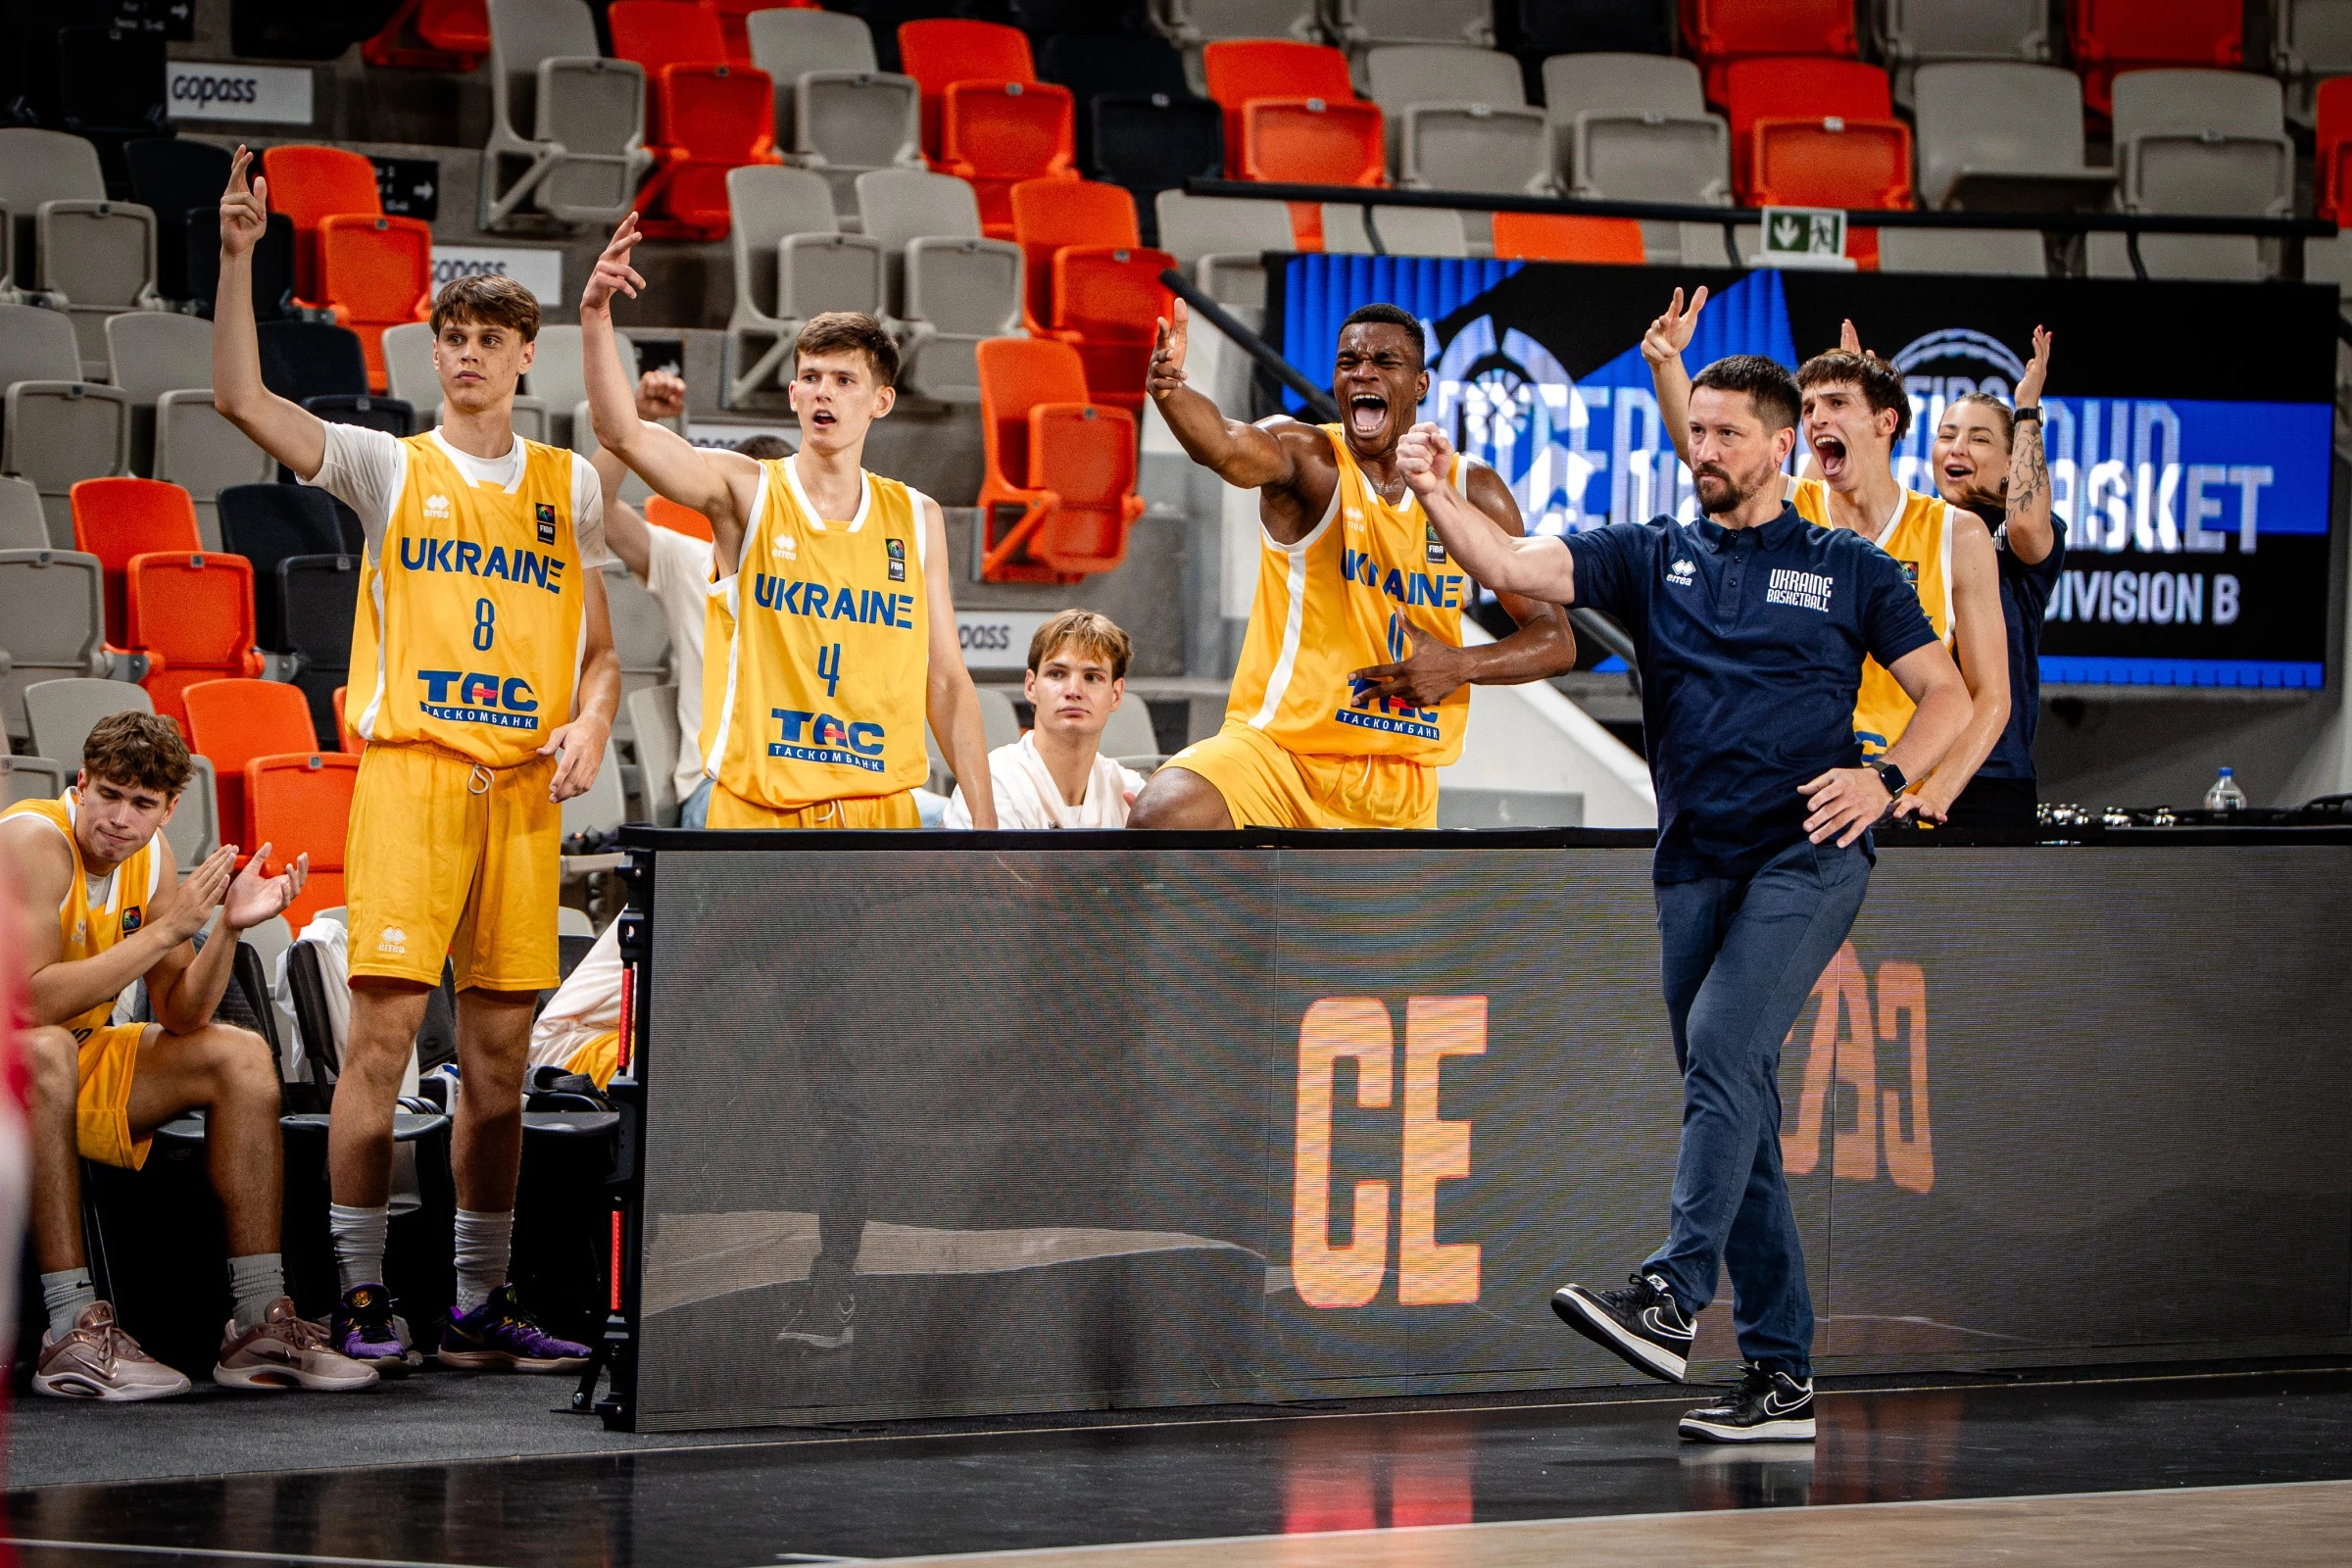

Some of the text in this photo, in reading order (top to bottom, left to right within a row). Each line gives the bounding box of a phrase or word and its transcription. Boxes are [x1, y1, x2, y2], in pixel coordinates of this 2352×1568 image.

[1428, 545, 1444, 554] FIBA
[400, 536, 566, 595] UKRAINE
[1769, 567, 1834, 598] UKRAINE
[754, 572, 914, 630] UKRAINE
[1766, 588, 1830, 613] BASKETBALL
[2212, 573, 2241, 625] B
[472, 597, 496, 652] 8
[816, 642, 841, 698] 4
[423, 704, 534, 729] ТАСКОМБАНК
[1342, 710, 1440, 740] ТАСКОМБАНК
[773, 744, 881, 772] ТАСКОМБАНК
